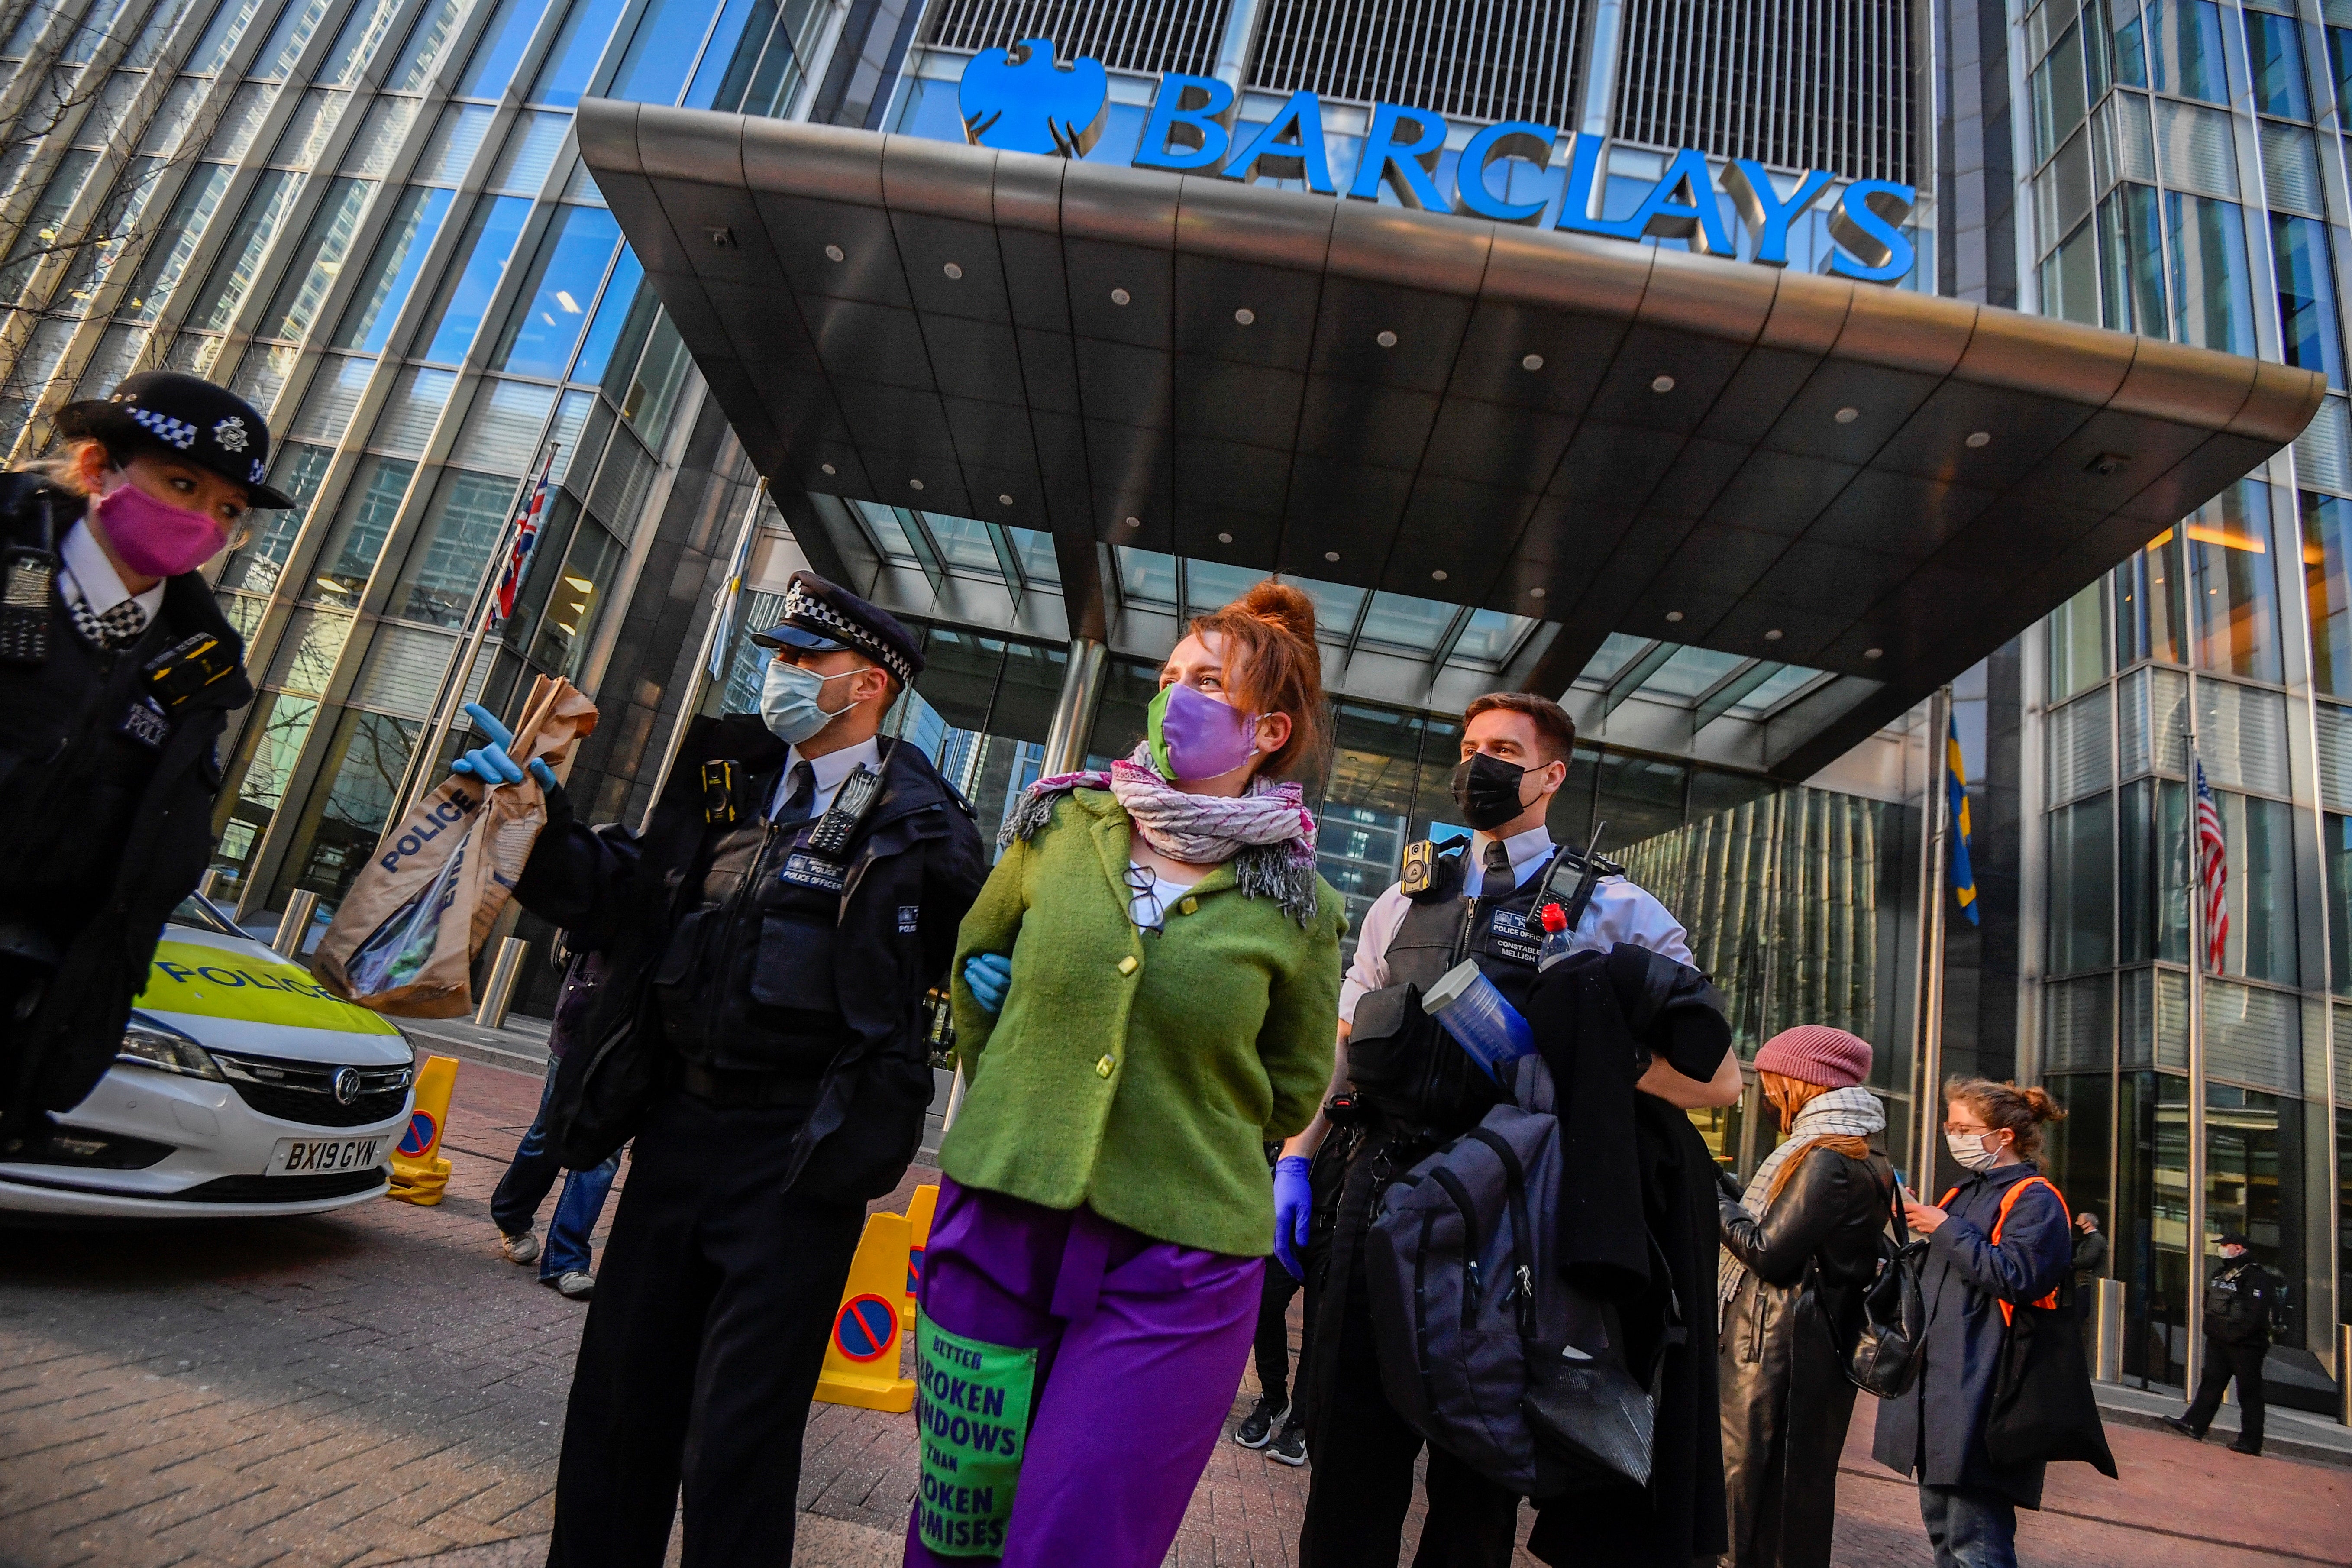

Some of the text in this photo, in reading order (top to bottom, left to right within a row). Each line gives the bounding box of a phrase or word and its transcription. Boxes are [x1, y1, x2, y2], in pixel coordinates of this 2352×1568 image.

[1132, 72, 1916, 283] BARCLAYS
[380, 788, 477, 874] POLICE
[783, 870, 843, 891] POLICE OFFICER
[1493, 924, 1519, 936] POLICE
[1497, 940, 1541, 956] CONSTABLE
[1501, 947, 1535, 962] MELLISH
[285, 1140, 377, 1170] BX19 GYN
[933, 1335, 982, 1370] BETTER
[927, 1441, 958, 1472] THAN
[921, 1468, 993, 1514] OKEN
